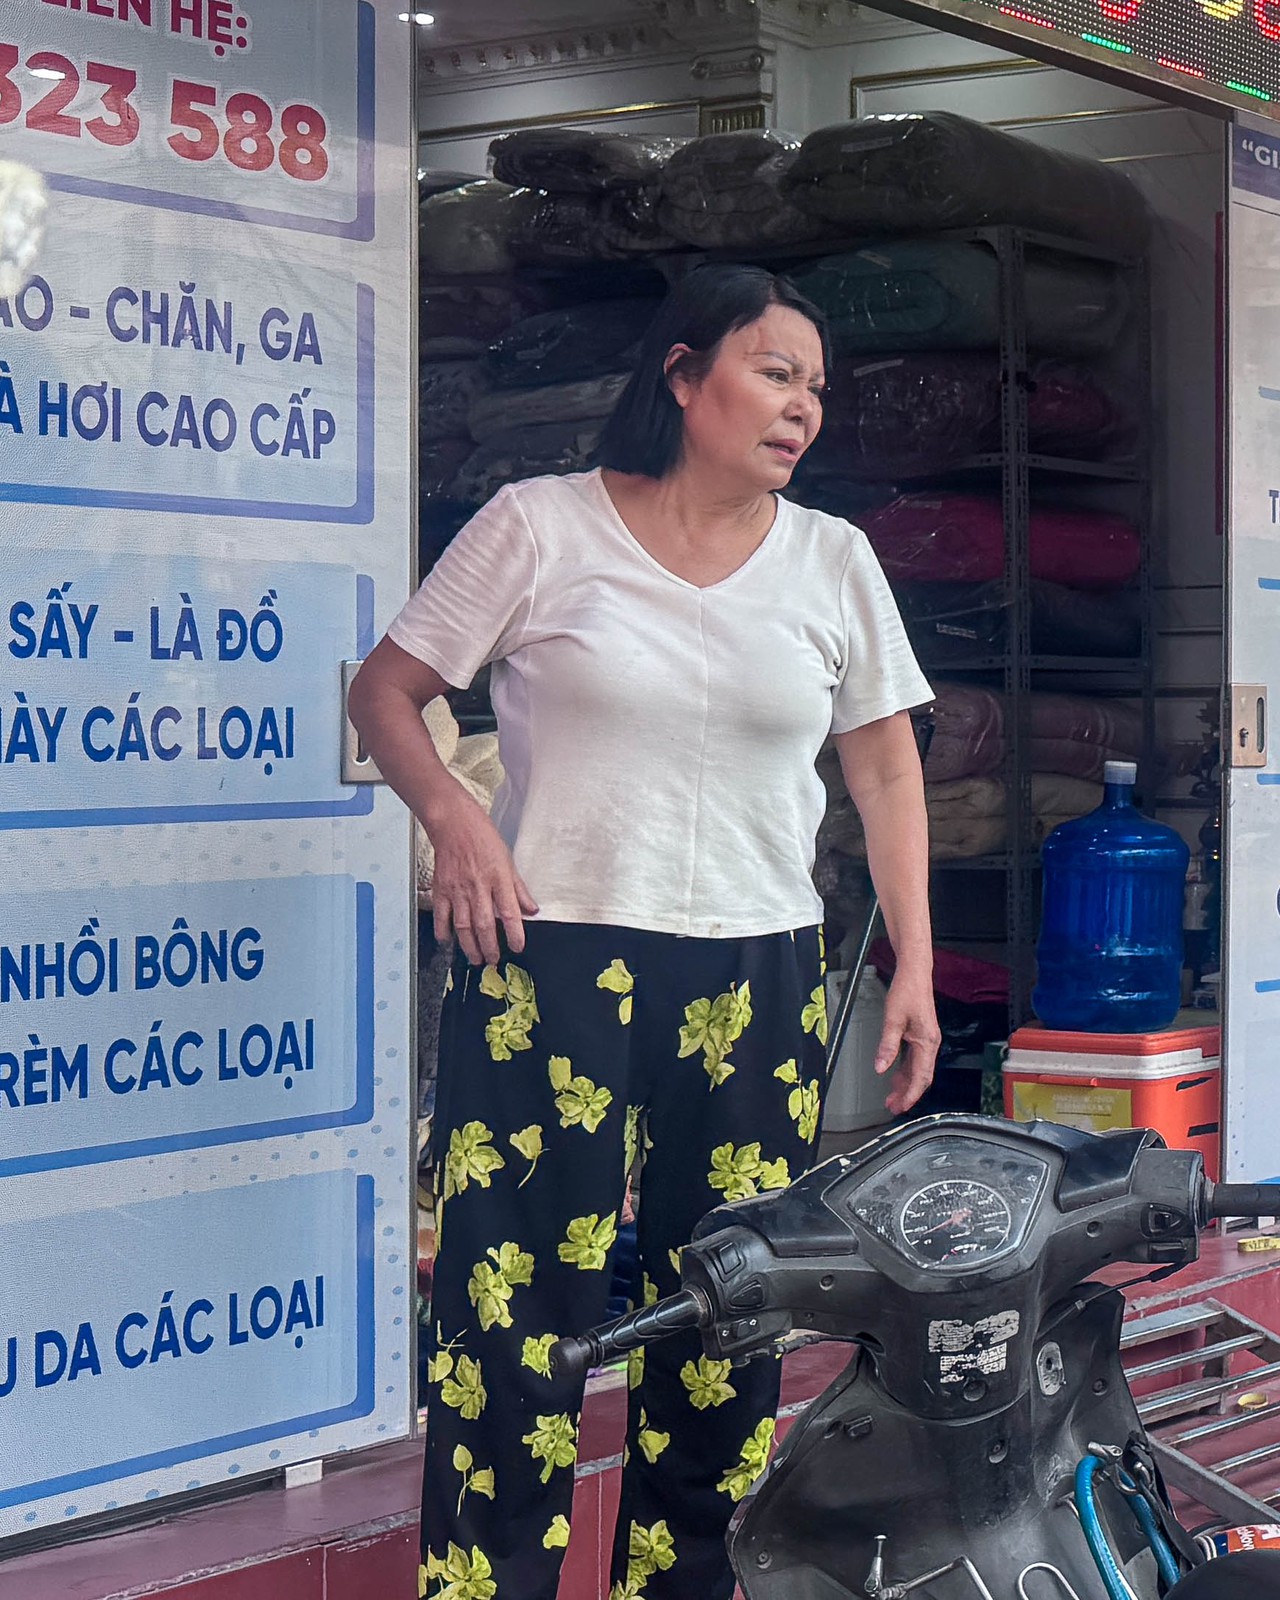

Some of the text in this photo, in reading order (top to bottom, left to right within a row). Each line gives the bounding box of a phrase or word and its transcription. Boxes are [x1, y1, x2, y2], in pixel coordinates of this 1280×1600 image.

[167, 79, 328, 182] 588
[70, 305, 90, 319] -
[106, 280, 245, 366] CHĂN,
[259, 307, 323, 366] GA
[39, 380, 121, 443] HƠI
[136, 390, 237, 453] CAO
[250, 387, 336, 460] CẤP
[8, 582, 283, 662] SẤY - LÀ ĐỒ
[0, 691, 294, 776] ÀY CÁC LOẠI
[0, 917, 264, 1002] NHỒI BÔNG
[0, 1018, 314, 1109] RÈM CÁC LOẠI
[34, 1321, 102, 1388] DA
[115, 1289, 214, 1371] CÁC
[228, 1275, 324, 1350] LOẠI
